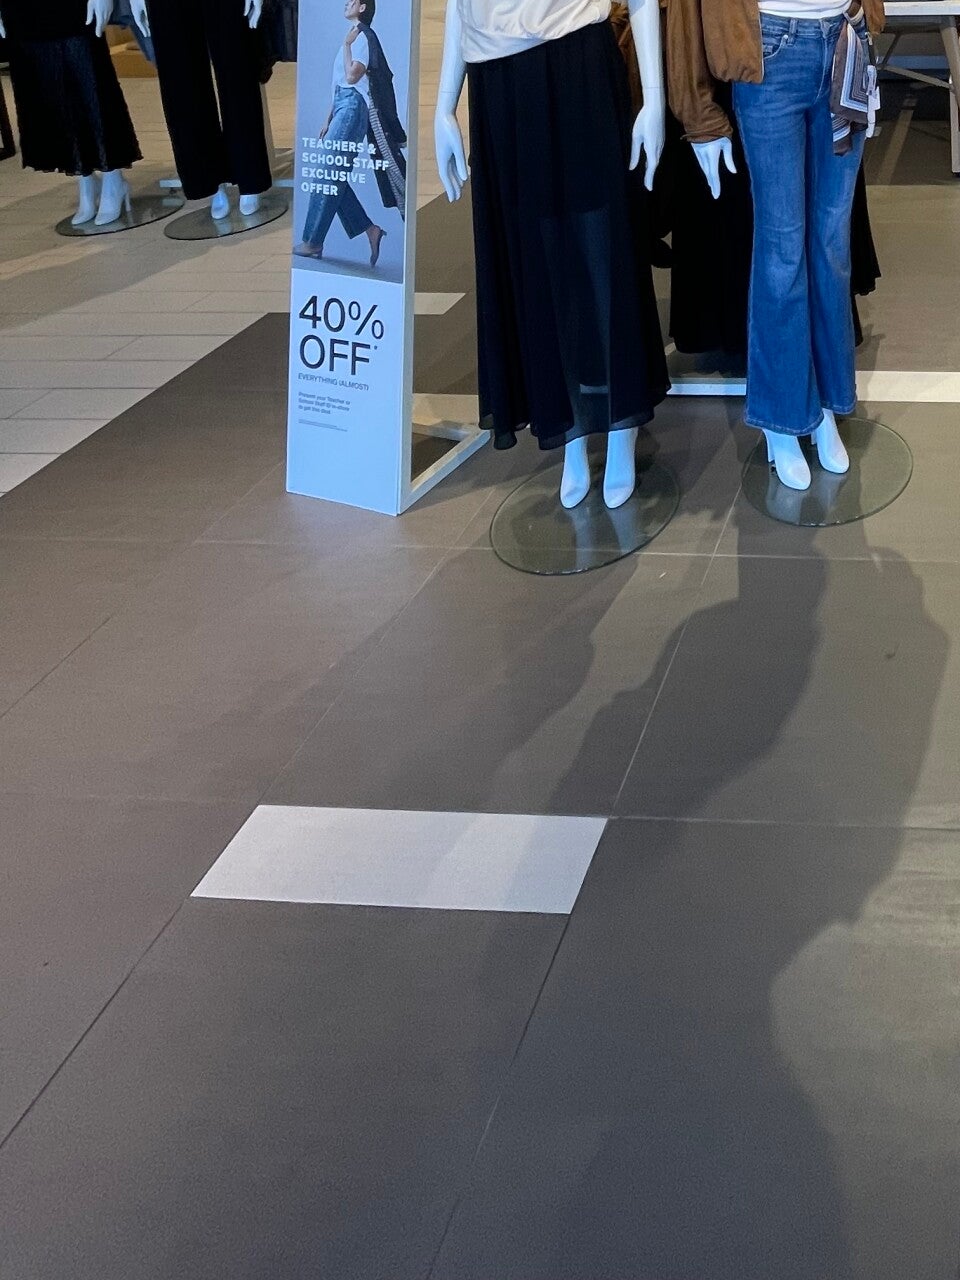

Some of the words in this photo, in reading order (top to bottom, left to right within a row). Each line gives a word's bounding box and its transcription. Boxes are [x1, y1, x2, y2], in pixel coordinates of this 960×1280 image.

[302, 137, 364, 153] TEACHERS
[367, 143, 377, 155] &
[302, 152, 351, 167] SCHOOL
[352, 157, 390, 171] STAFF
[301, 167, 367, 184] EXCLUSIVE
[301, 182, 339, 196] OFFER
[299, 295, 385, 340] 40%
[298, 372, 338, 386] EVERYTHING
